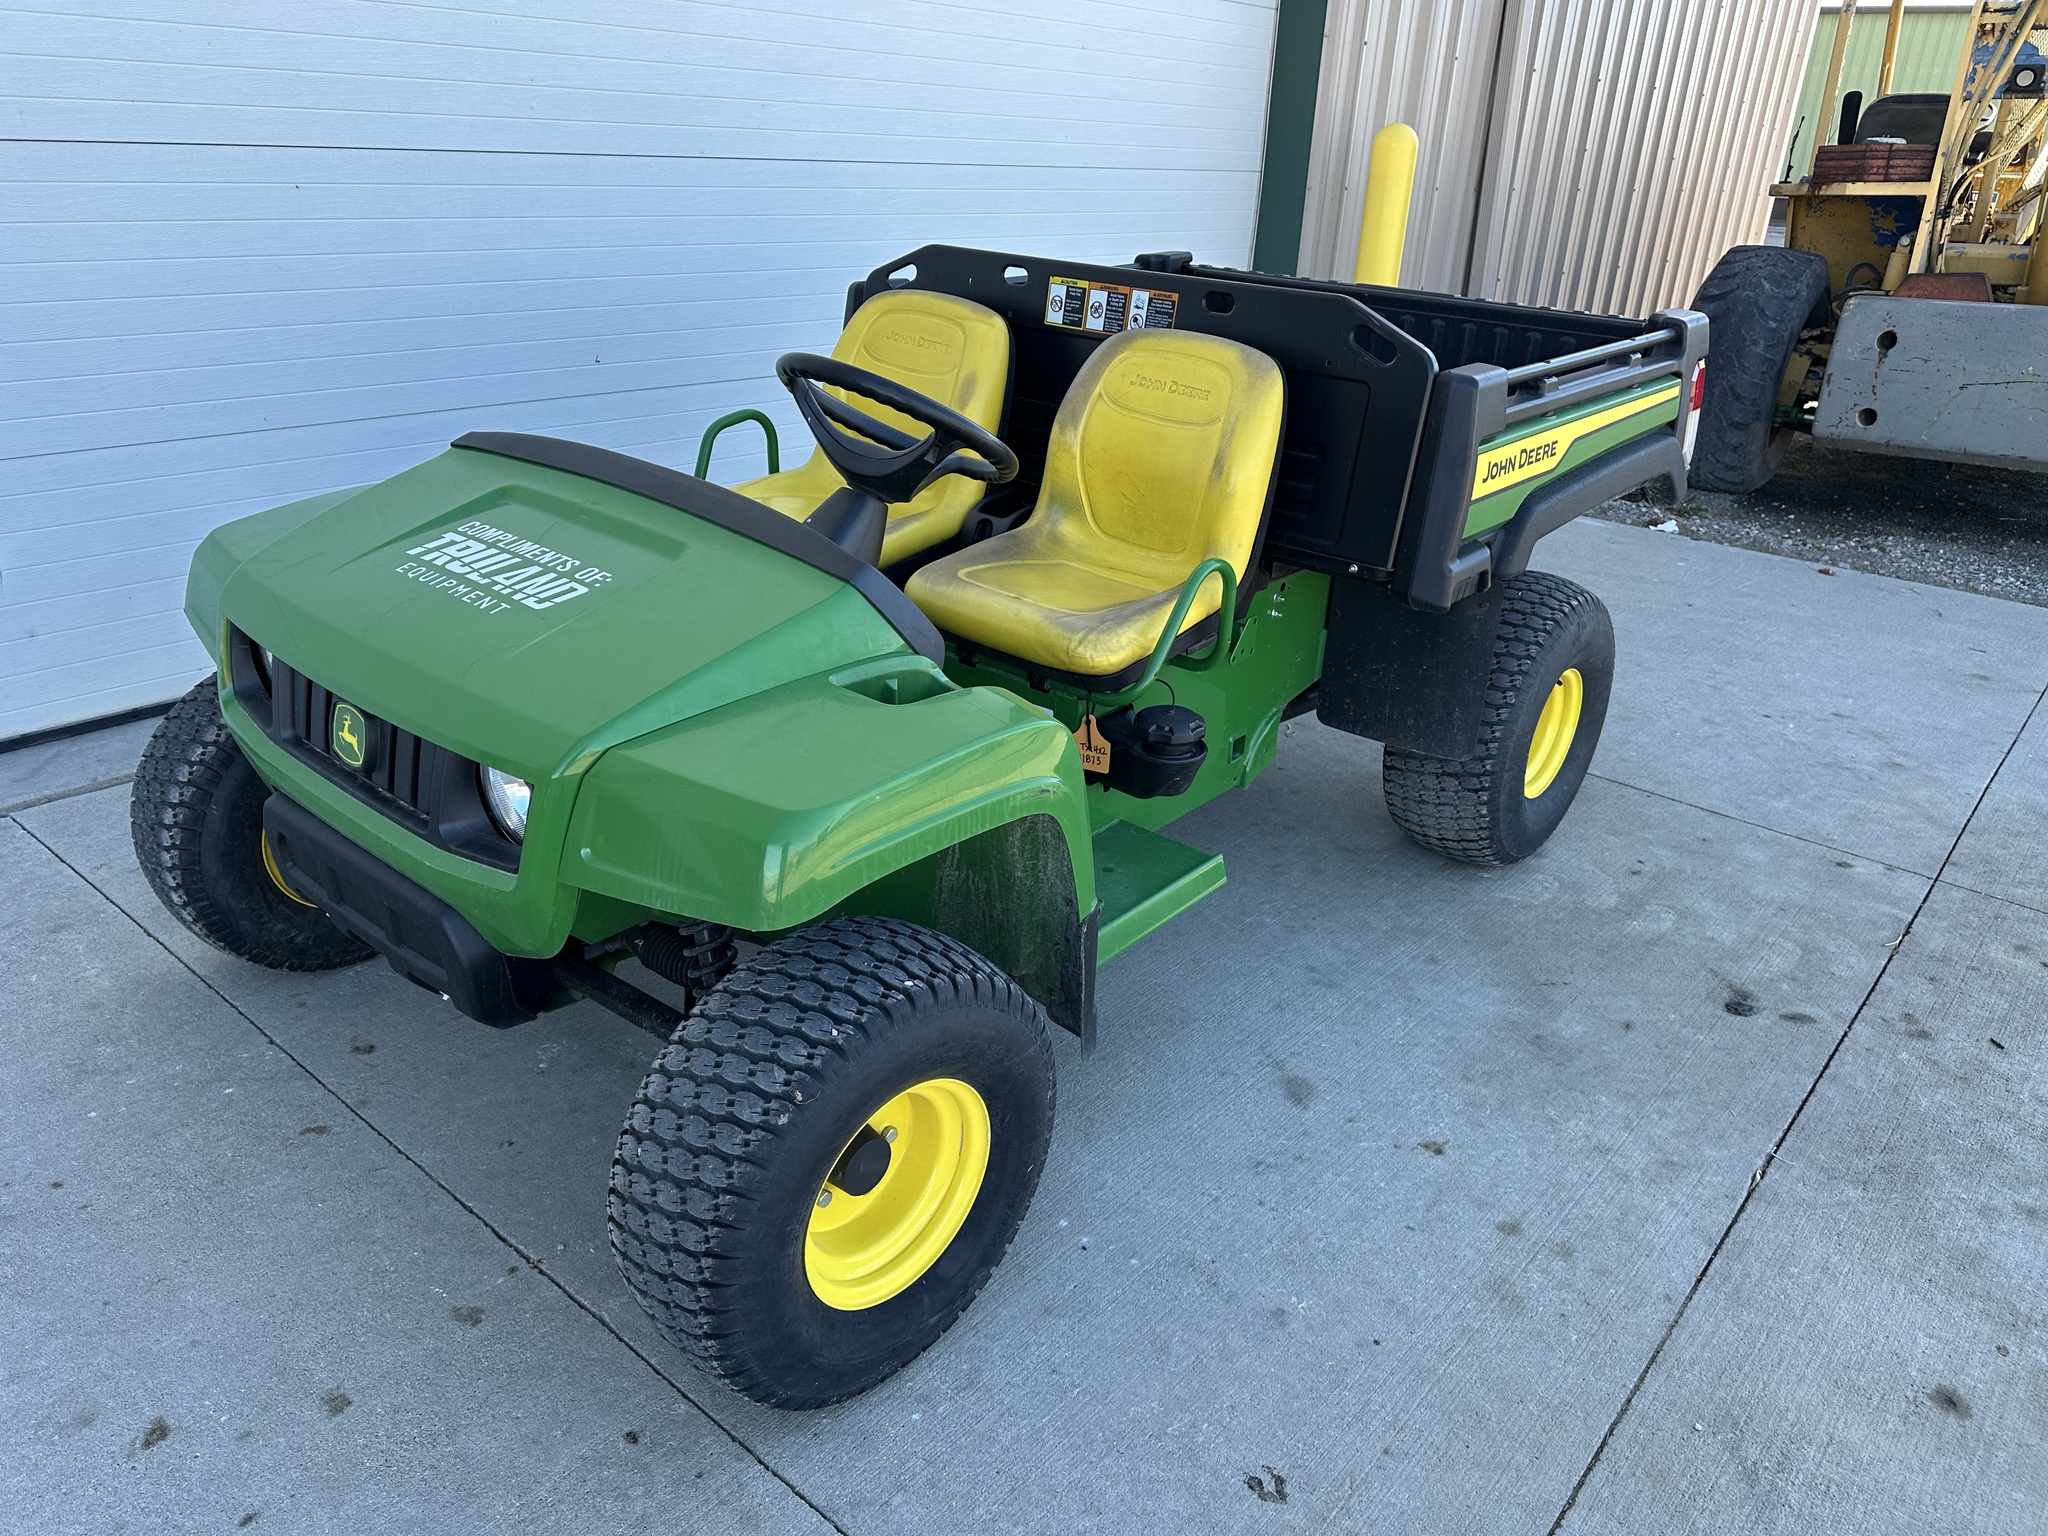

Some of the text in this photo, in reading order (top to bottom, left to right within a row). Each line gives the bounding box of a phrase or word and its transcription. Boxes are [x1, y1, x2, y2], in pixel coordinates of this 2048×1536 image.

[885, 329, 950, 355] JOHN DEERE
[1129, 373, 1211, 401] JOHN DEERE
[1482, 440, 1558, 484] JOHN DEERE
[456, 520, 613, 588] COMPLIMENTS OF:
[394, 561, 511, 615] EQUIPMENT
[1082, 753, 1102, 766] 1873
